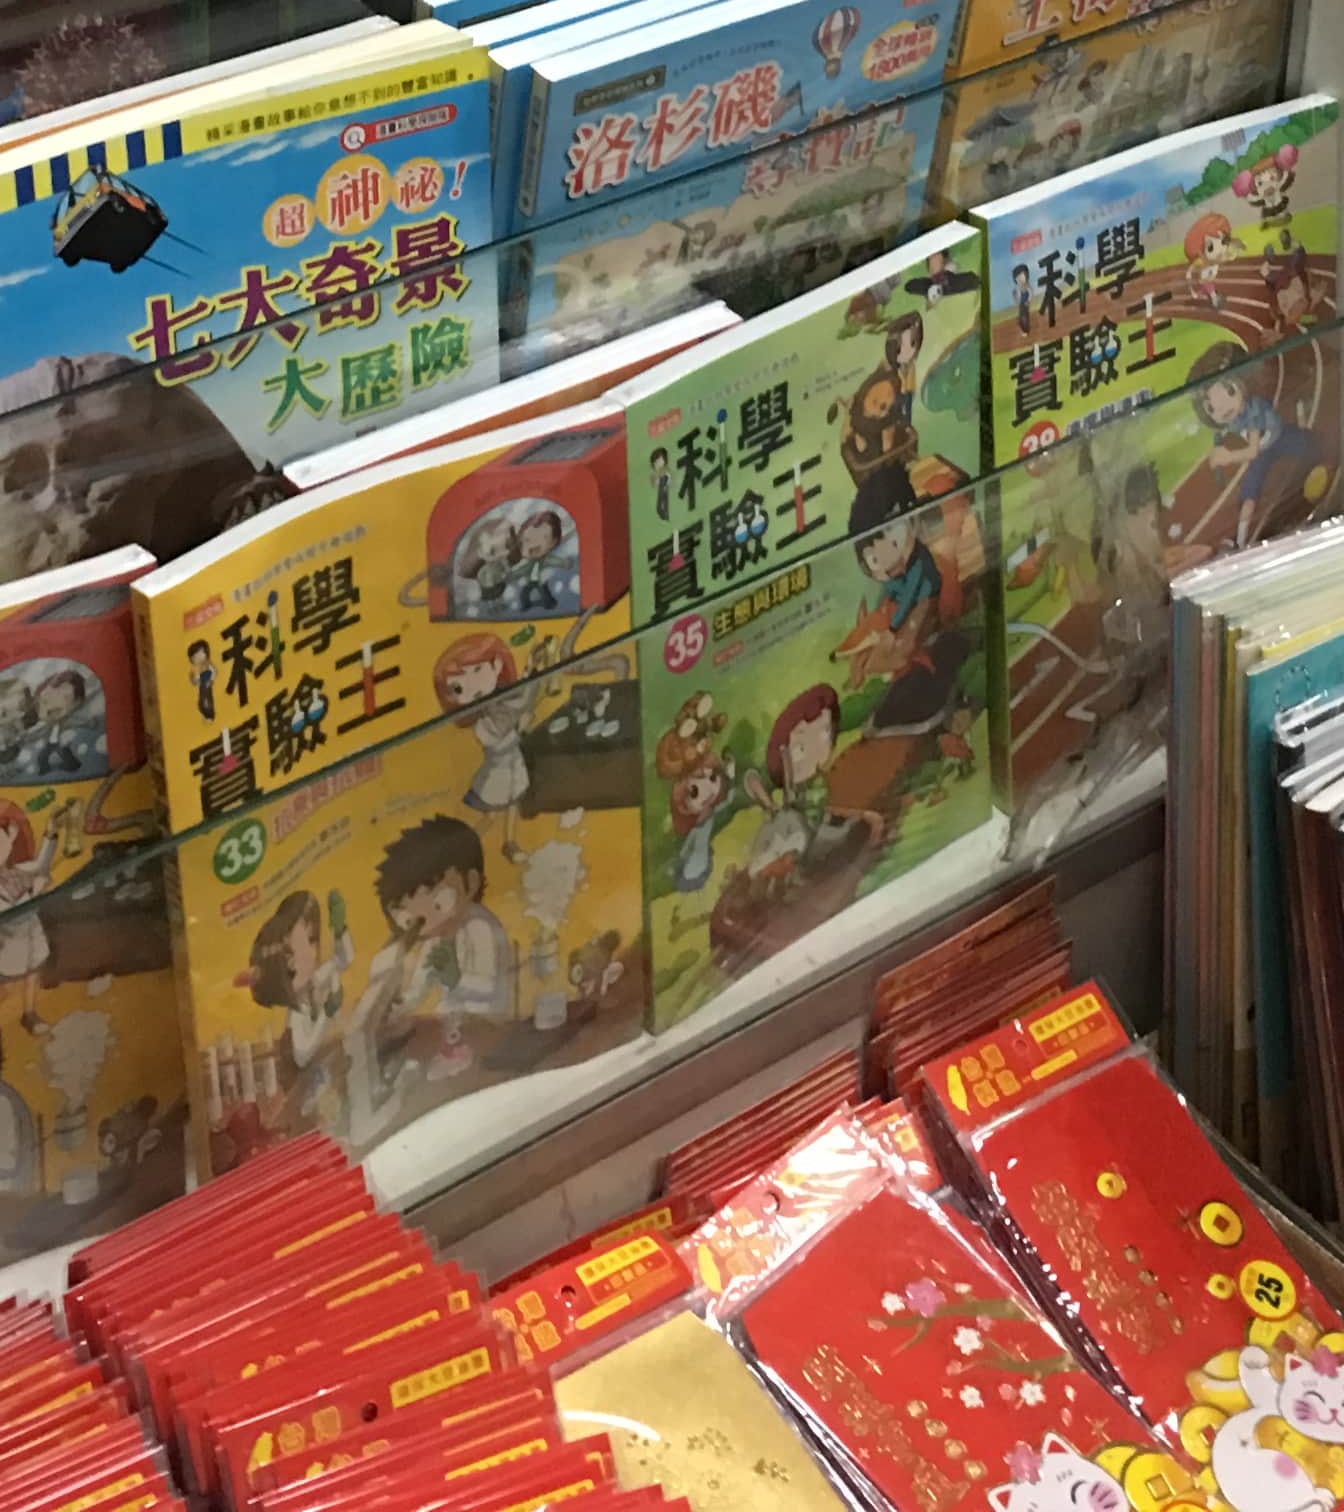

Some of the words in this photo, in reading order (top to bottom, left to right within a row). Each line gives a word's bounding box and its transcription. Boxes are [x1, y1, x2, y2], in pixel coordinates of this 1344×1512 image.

[128, 214, 471, 386] 七大奇景
[1037, 216, 1146, 329] 科學
[261, 318, 471, 433] 大歷險
[1008, 290, 1177, 429] 實驗王
[677, 381, 795, 513] 科學
[647, 453, 832, 623] 實驗王
[221, 556, 360, 708] 科學
[666, 616, 705, 668] 35
[189, 631, 408, 824] 實驗王
[220, 824, 265, 878] 33
